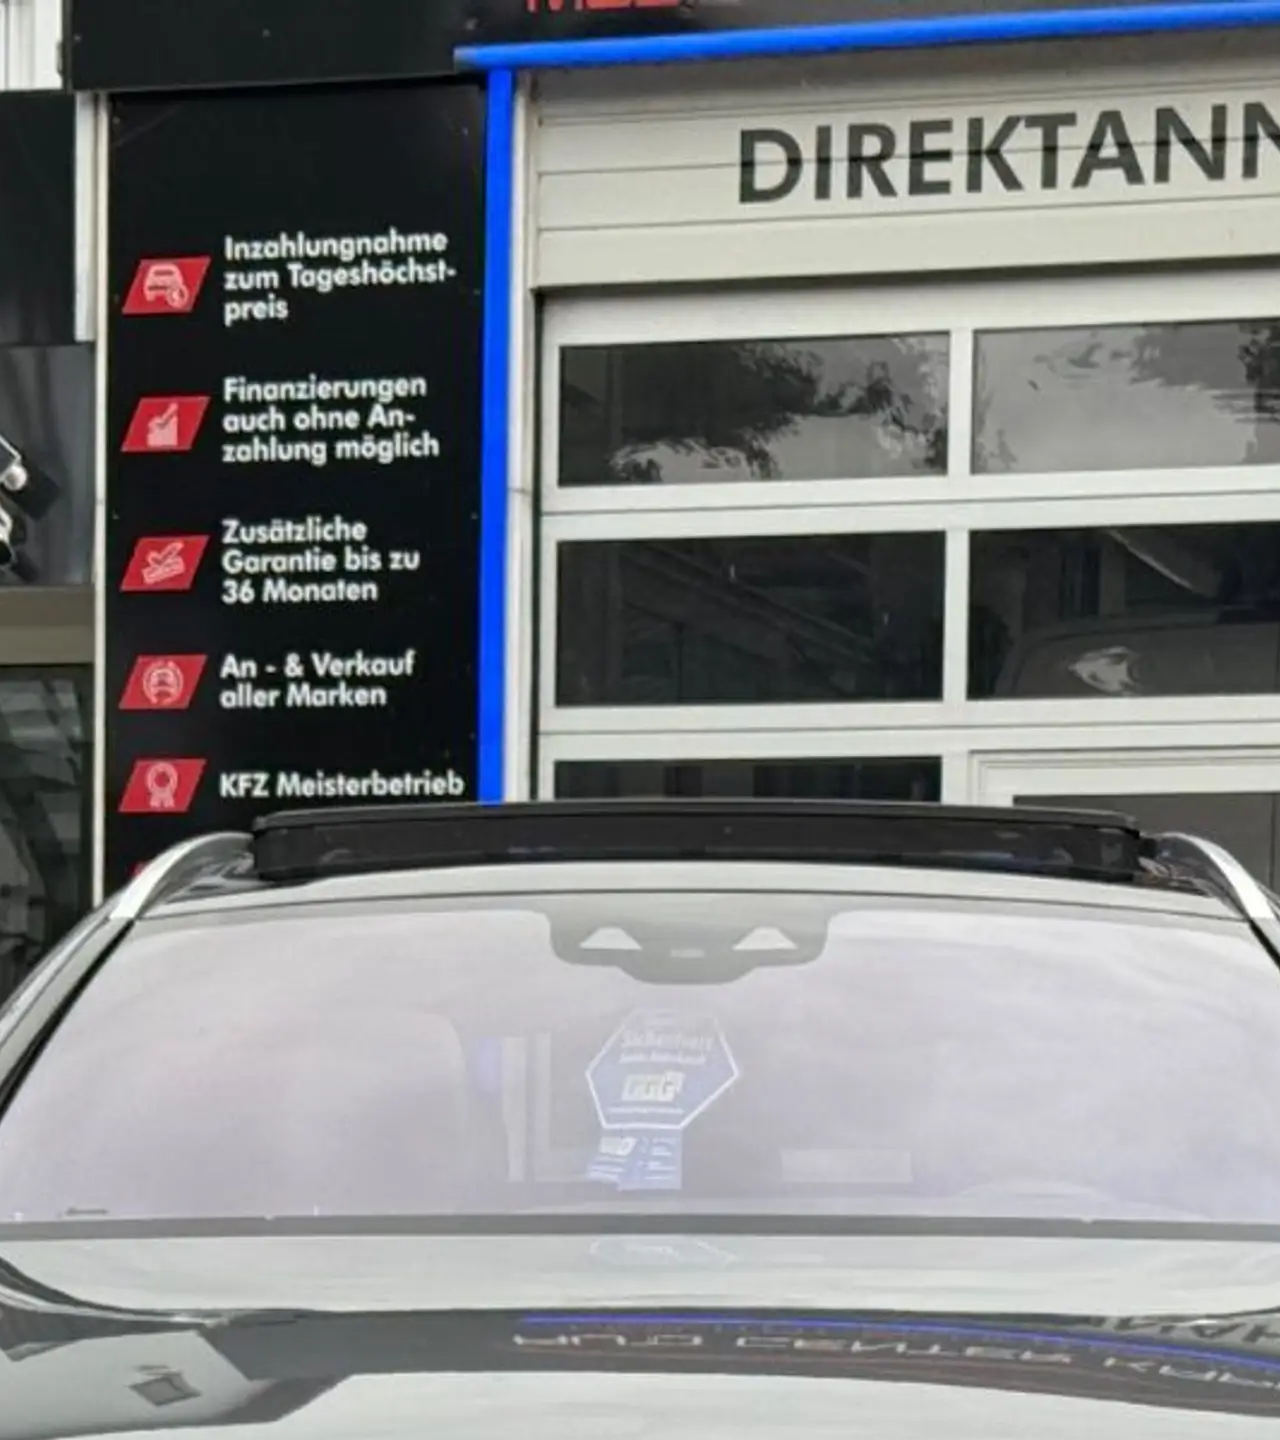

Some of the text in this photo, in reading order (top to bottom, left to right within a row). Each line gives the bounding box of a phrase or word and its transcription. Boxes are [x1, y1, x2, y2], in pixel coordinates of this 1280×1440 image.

[224, 226, 448, 260] Inzahlungnahme
[224, 258, 457, 294] zum Tageshöchst-
[224, 295, 289, 326] preis
[224, 373, 427, 404] Finanzierungen
[222, 404, 416, 433] auch ohne An-
[222, 430, 440, 466] zahlung möglich
[222, 514, 367, 545] Zusätzliche
[222, 546, 421, 575] Garantie bis zu
[222, 578, 378, 604] 36 Monaten
[220, 655, 257, 678] An
[284, 654, 303, 678] &
[311, 649, 417, 677] Verkauf
[220, 683, 388, 708] aller Marken
[220, 769, 464, 798] KFZ Meisterbetrieb
